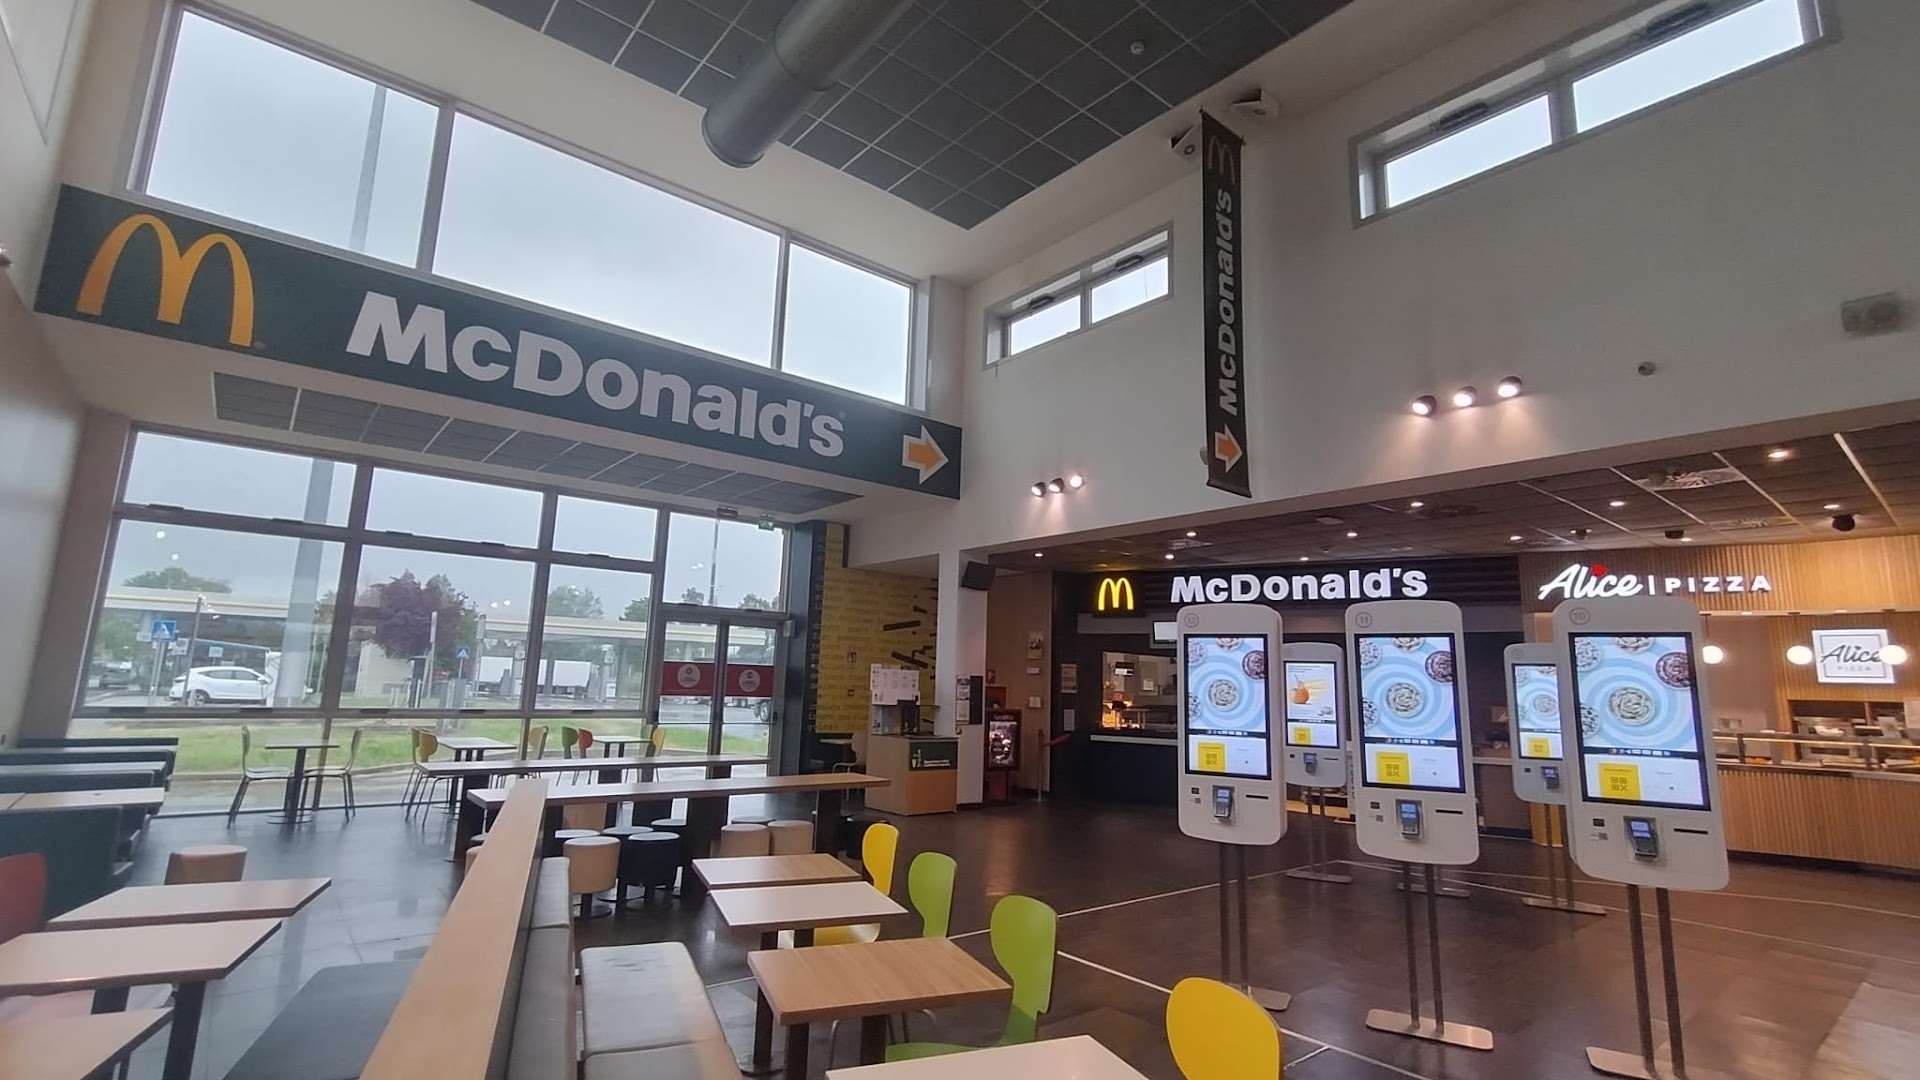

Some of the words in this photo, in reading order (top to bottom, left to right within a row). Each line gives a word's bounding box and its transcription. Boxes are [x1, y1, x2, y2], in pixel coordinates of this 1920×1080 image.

[1215, 188, 1238, 416] McDonald's
[346, 291, 846, 458] McDonald's
[1170, 568, 1428, 603] McDonald's
[1538, 563, 1644, 600] Alice
[1665, 575, 1773, 594] PIZZA
